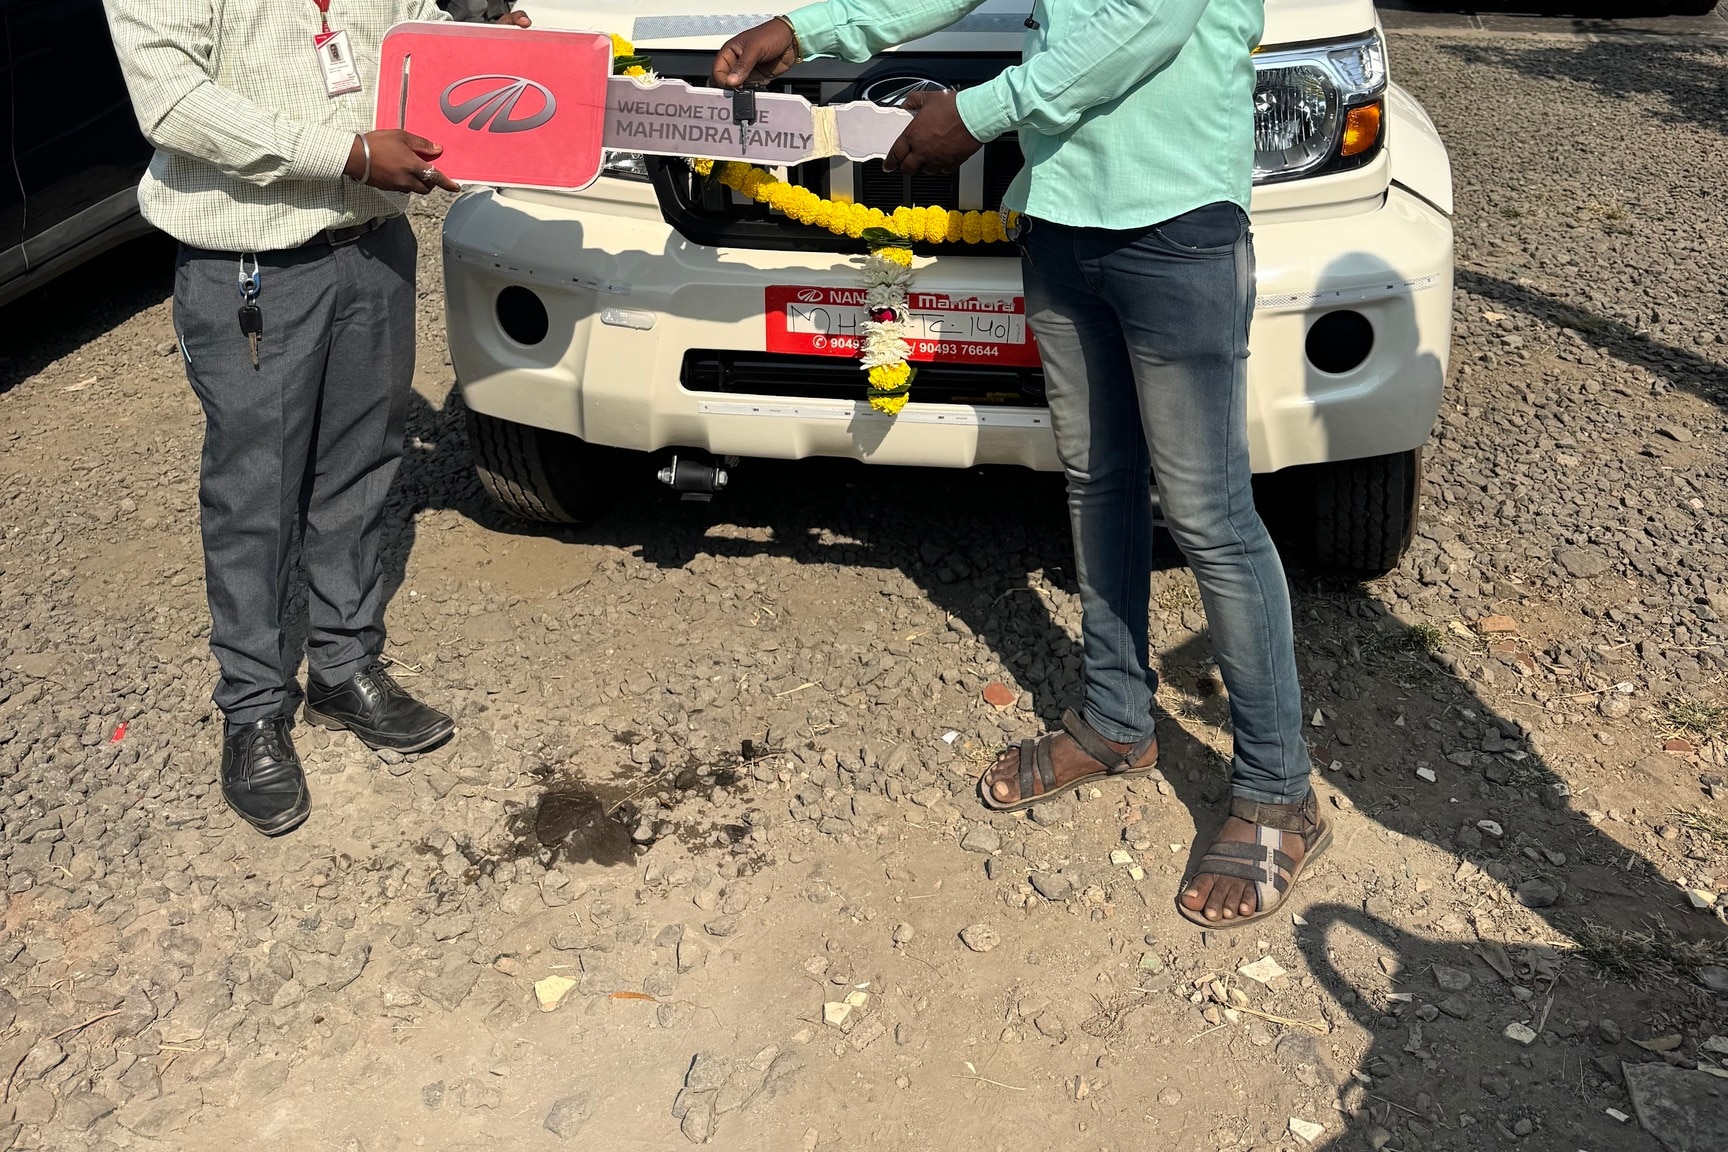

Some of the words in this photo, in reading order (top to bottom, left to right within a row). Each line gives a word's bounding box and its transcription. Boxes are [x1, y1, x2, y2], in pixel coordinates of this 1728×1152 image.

[617, 100, 704, 119] WELCOME
[707, 106, 731, 121] TO
[615, 119, 733, 144] MAHINDRA
[919, 342, 957, 354] 90493
[961, 344, 999, 357] 76644
